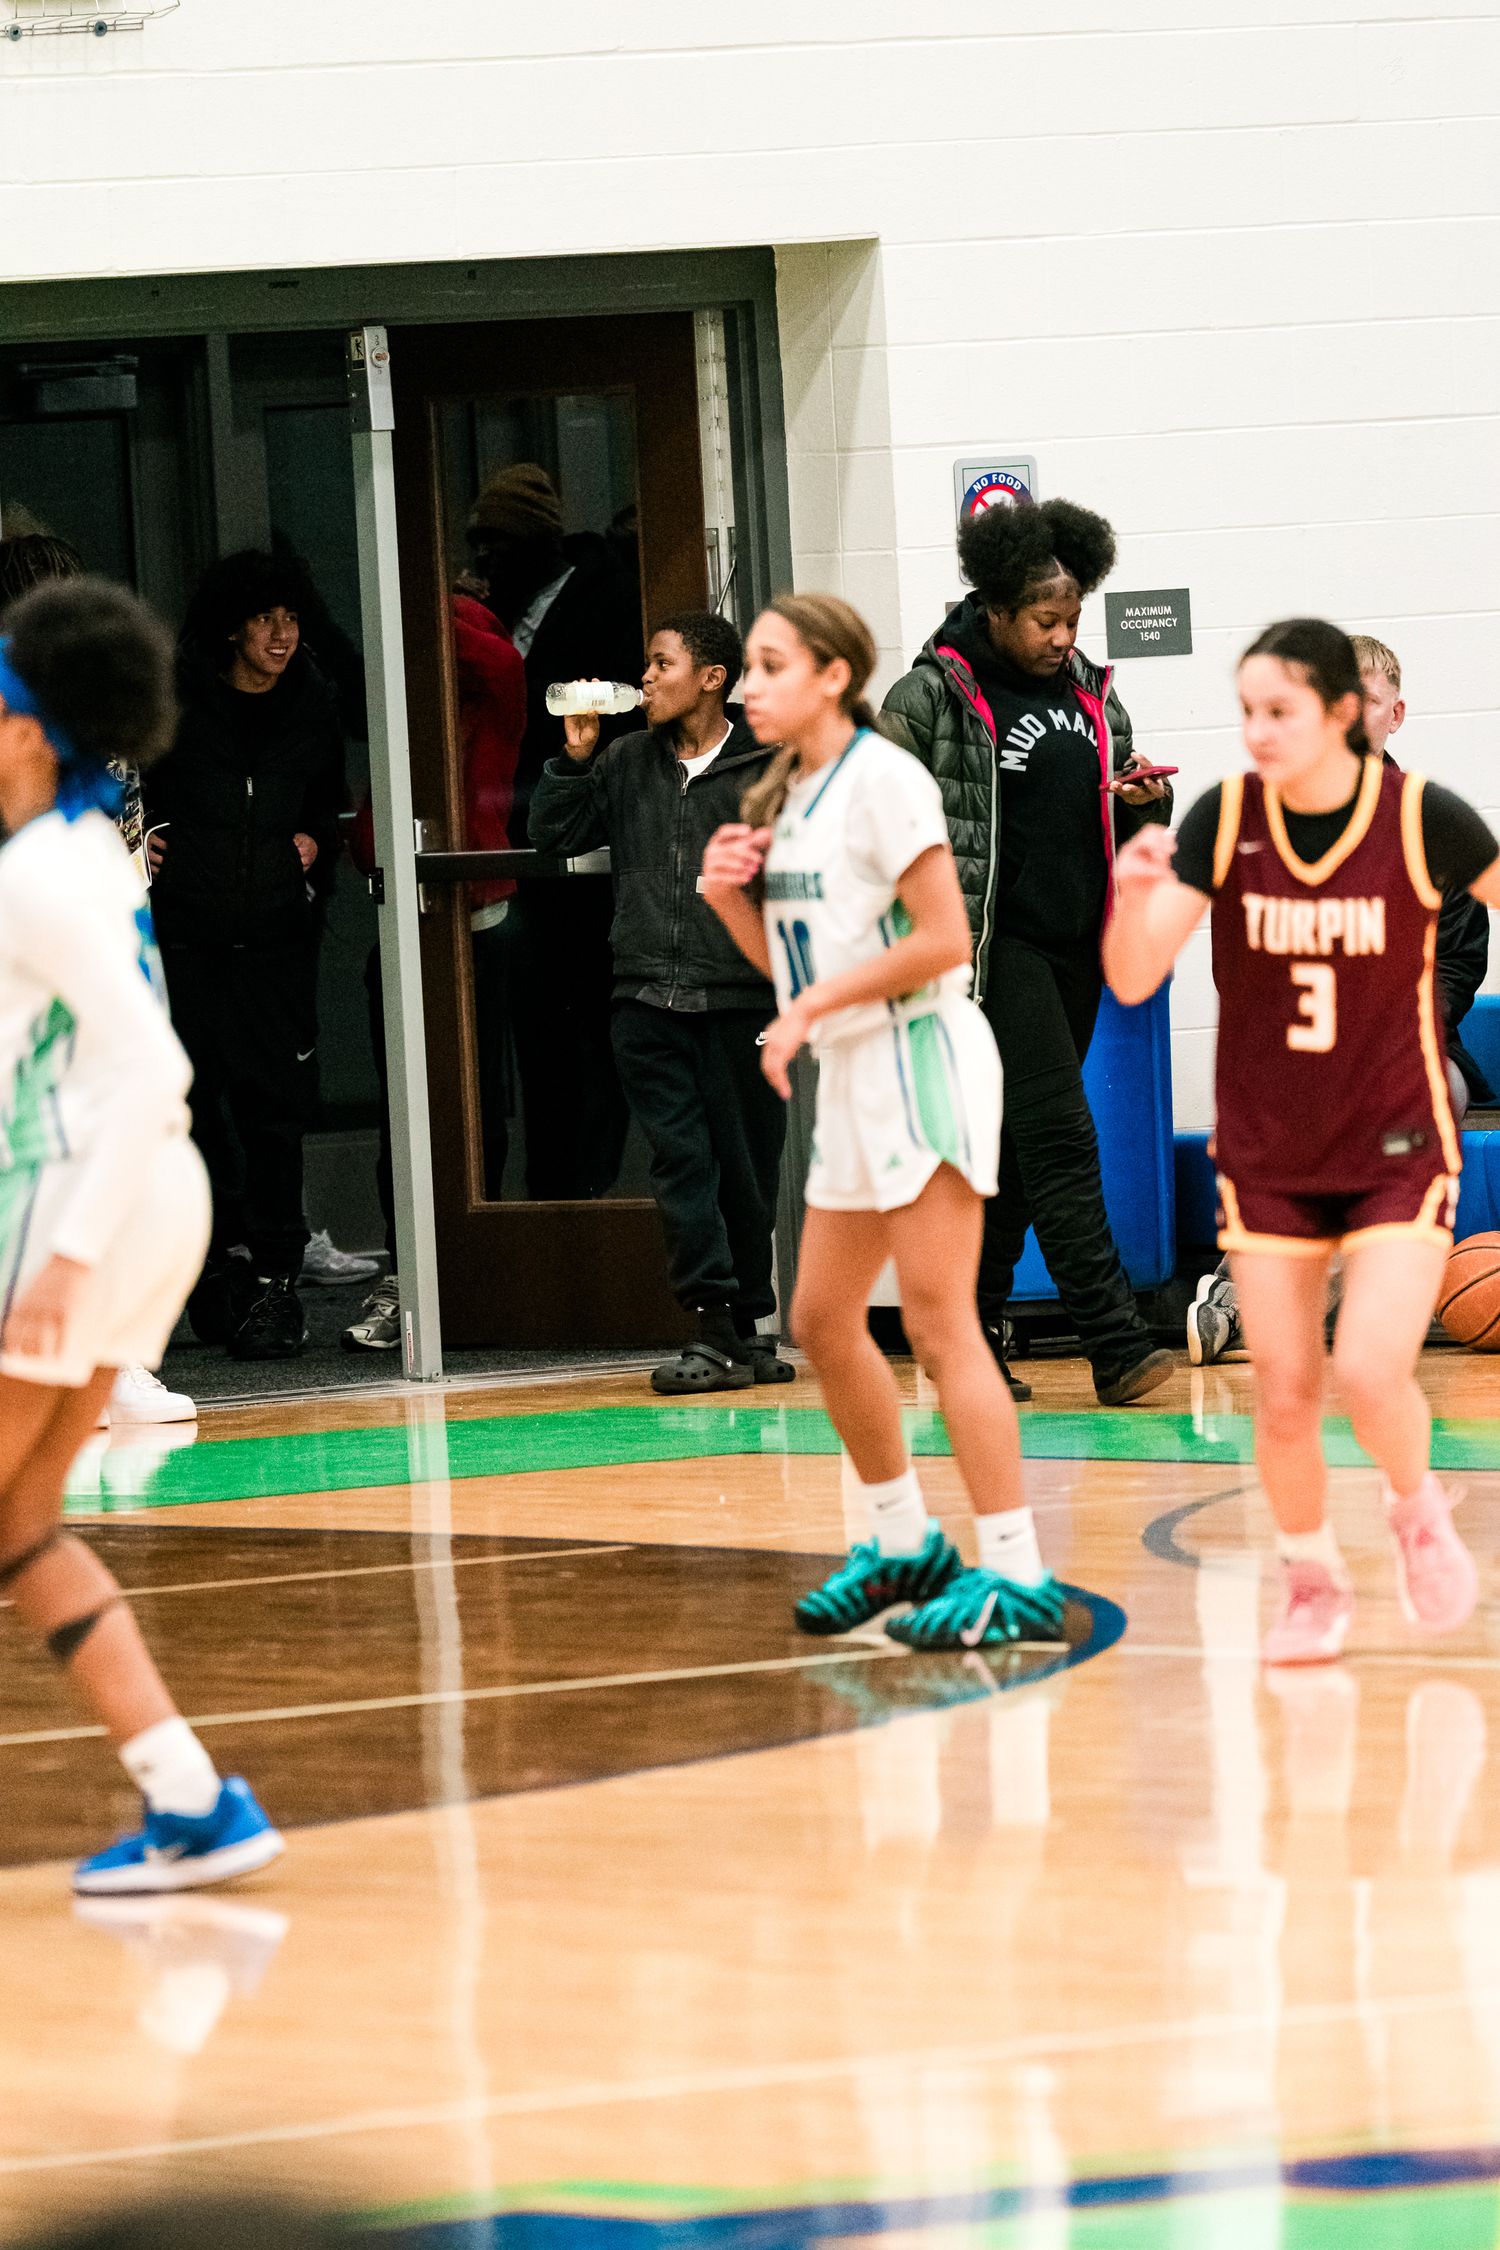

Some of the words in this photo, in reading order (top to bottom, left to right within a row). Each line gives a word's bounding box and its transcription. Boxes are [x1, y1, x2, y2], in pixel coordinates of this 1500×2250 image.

[972, 477, 989, 493] NO
[991, 473, 1022, 491] FOOD
[1125, 605, 1172, 617] MAXIMUM
[1120, 617, 1178, 630] OCCUPANCY
[1139, 631, 1161, 641] 1540
[999, 712, 1047, 772] MUD
[1242, 892, 1386, 957] TURPIN
[1286, 962, 1337, 1053] 3
